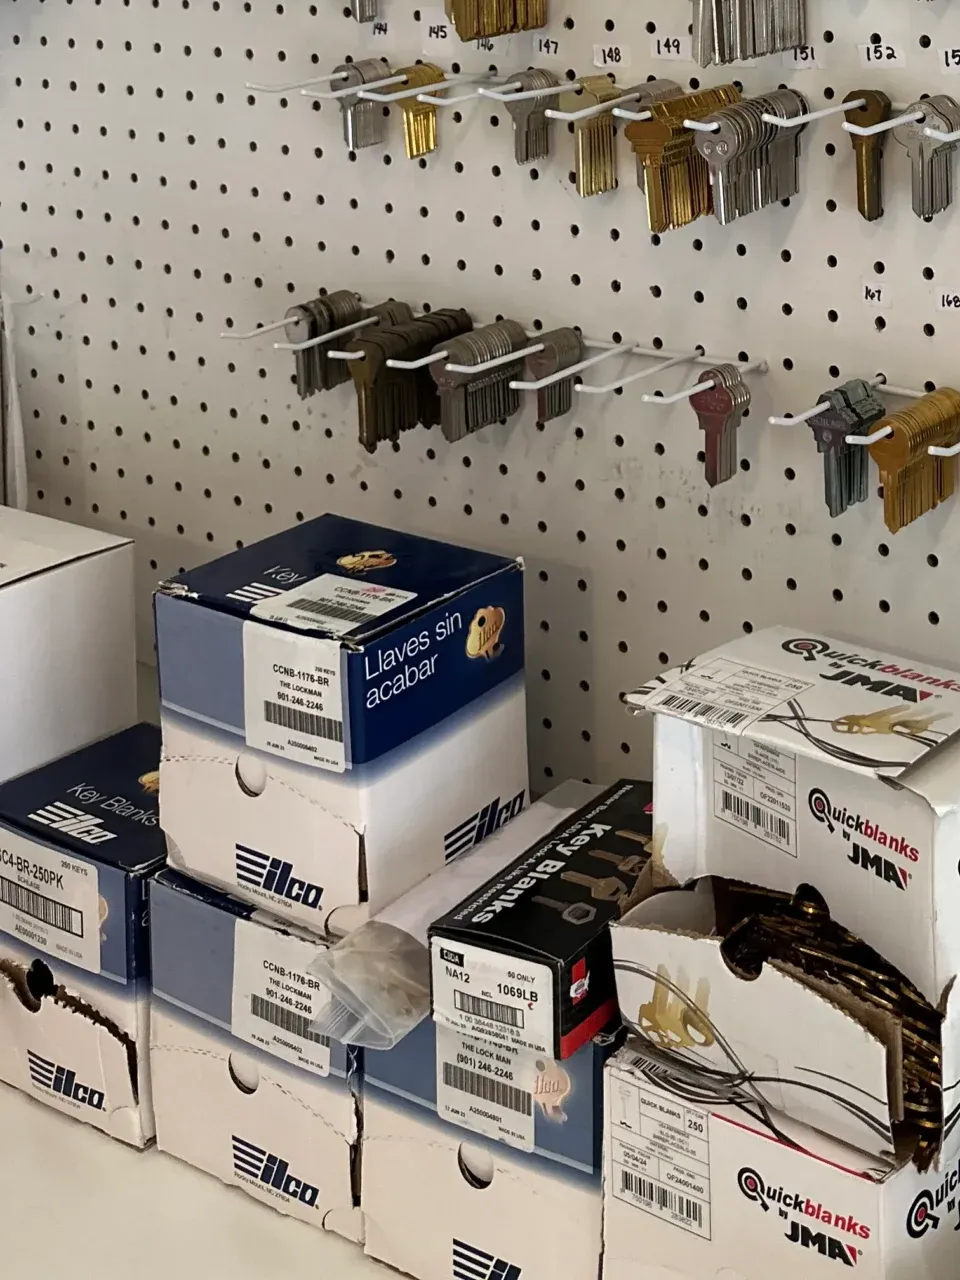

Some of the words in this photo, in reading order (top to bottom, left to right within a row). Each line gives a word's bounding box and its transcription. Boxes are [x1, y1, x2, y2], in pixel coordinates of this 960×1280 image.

[429, 25, 447, 38] 145
[539, 39, 558, 53] 147
[602, 48, 621, 63] 148
[657, 40, 680, 54] 149
[793, 47, 815, 60] 151
[866, 46, 897, 60] 152
[864, 287, 882, 301] 167
[263, 565, 307, 584] Key
[365, 631, 430, 680] Llaves
[435, 612, 462, 640] sin
[272, 663, 330, 687] CCNB-1176-BR
[366, 654, 438, 709] acabar
[818, 669, 934, 703] JMA
[277, 691, 324, 711] 901-246-2246
[280, 680, 291, 690] THE
[292, 683, 322, 698] LOCKMAN
[67, 782, 103, 804] Key
[100, 795, 158, 826] Blanks
[556, 823, 612, 857] Key
[0, 848, 64, 891] C4-BR-250PK
[71, 863, 88, 877] KEYS
[847, 842, 910, 891] JMA
[262, 857, 324, 909] ilco
[471, 859, 567, 924] Blanks
[263, 960, 320, 991] CCNB-1176-BR
[445, 966, 470, 984] NA12
[516, 972, 536, 984] ONLY
[265, 987, 312, 1015] 901-246-2246
[269, 977, 280, 987] THE
[281, 982, 312, 1001] LOCKMAN
[497, 983, 538, 1004] 1069LB
[461, 1041, 475, 1054] THE
[475, 1045, 495, 1060] LOCK
[456, 1053, 477, 1070] (901)
[477, 1059, 514, 1081] 246-2246
[53, 1065, 104, 1111] ilco
[687, 1119, 704, 1134] 250
[260, 1152, 319, 1207] ilco
[784, 1220, 860, 1268] JMA
